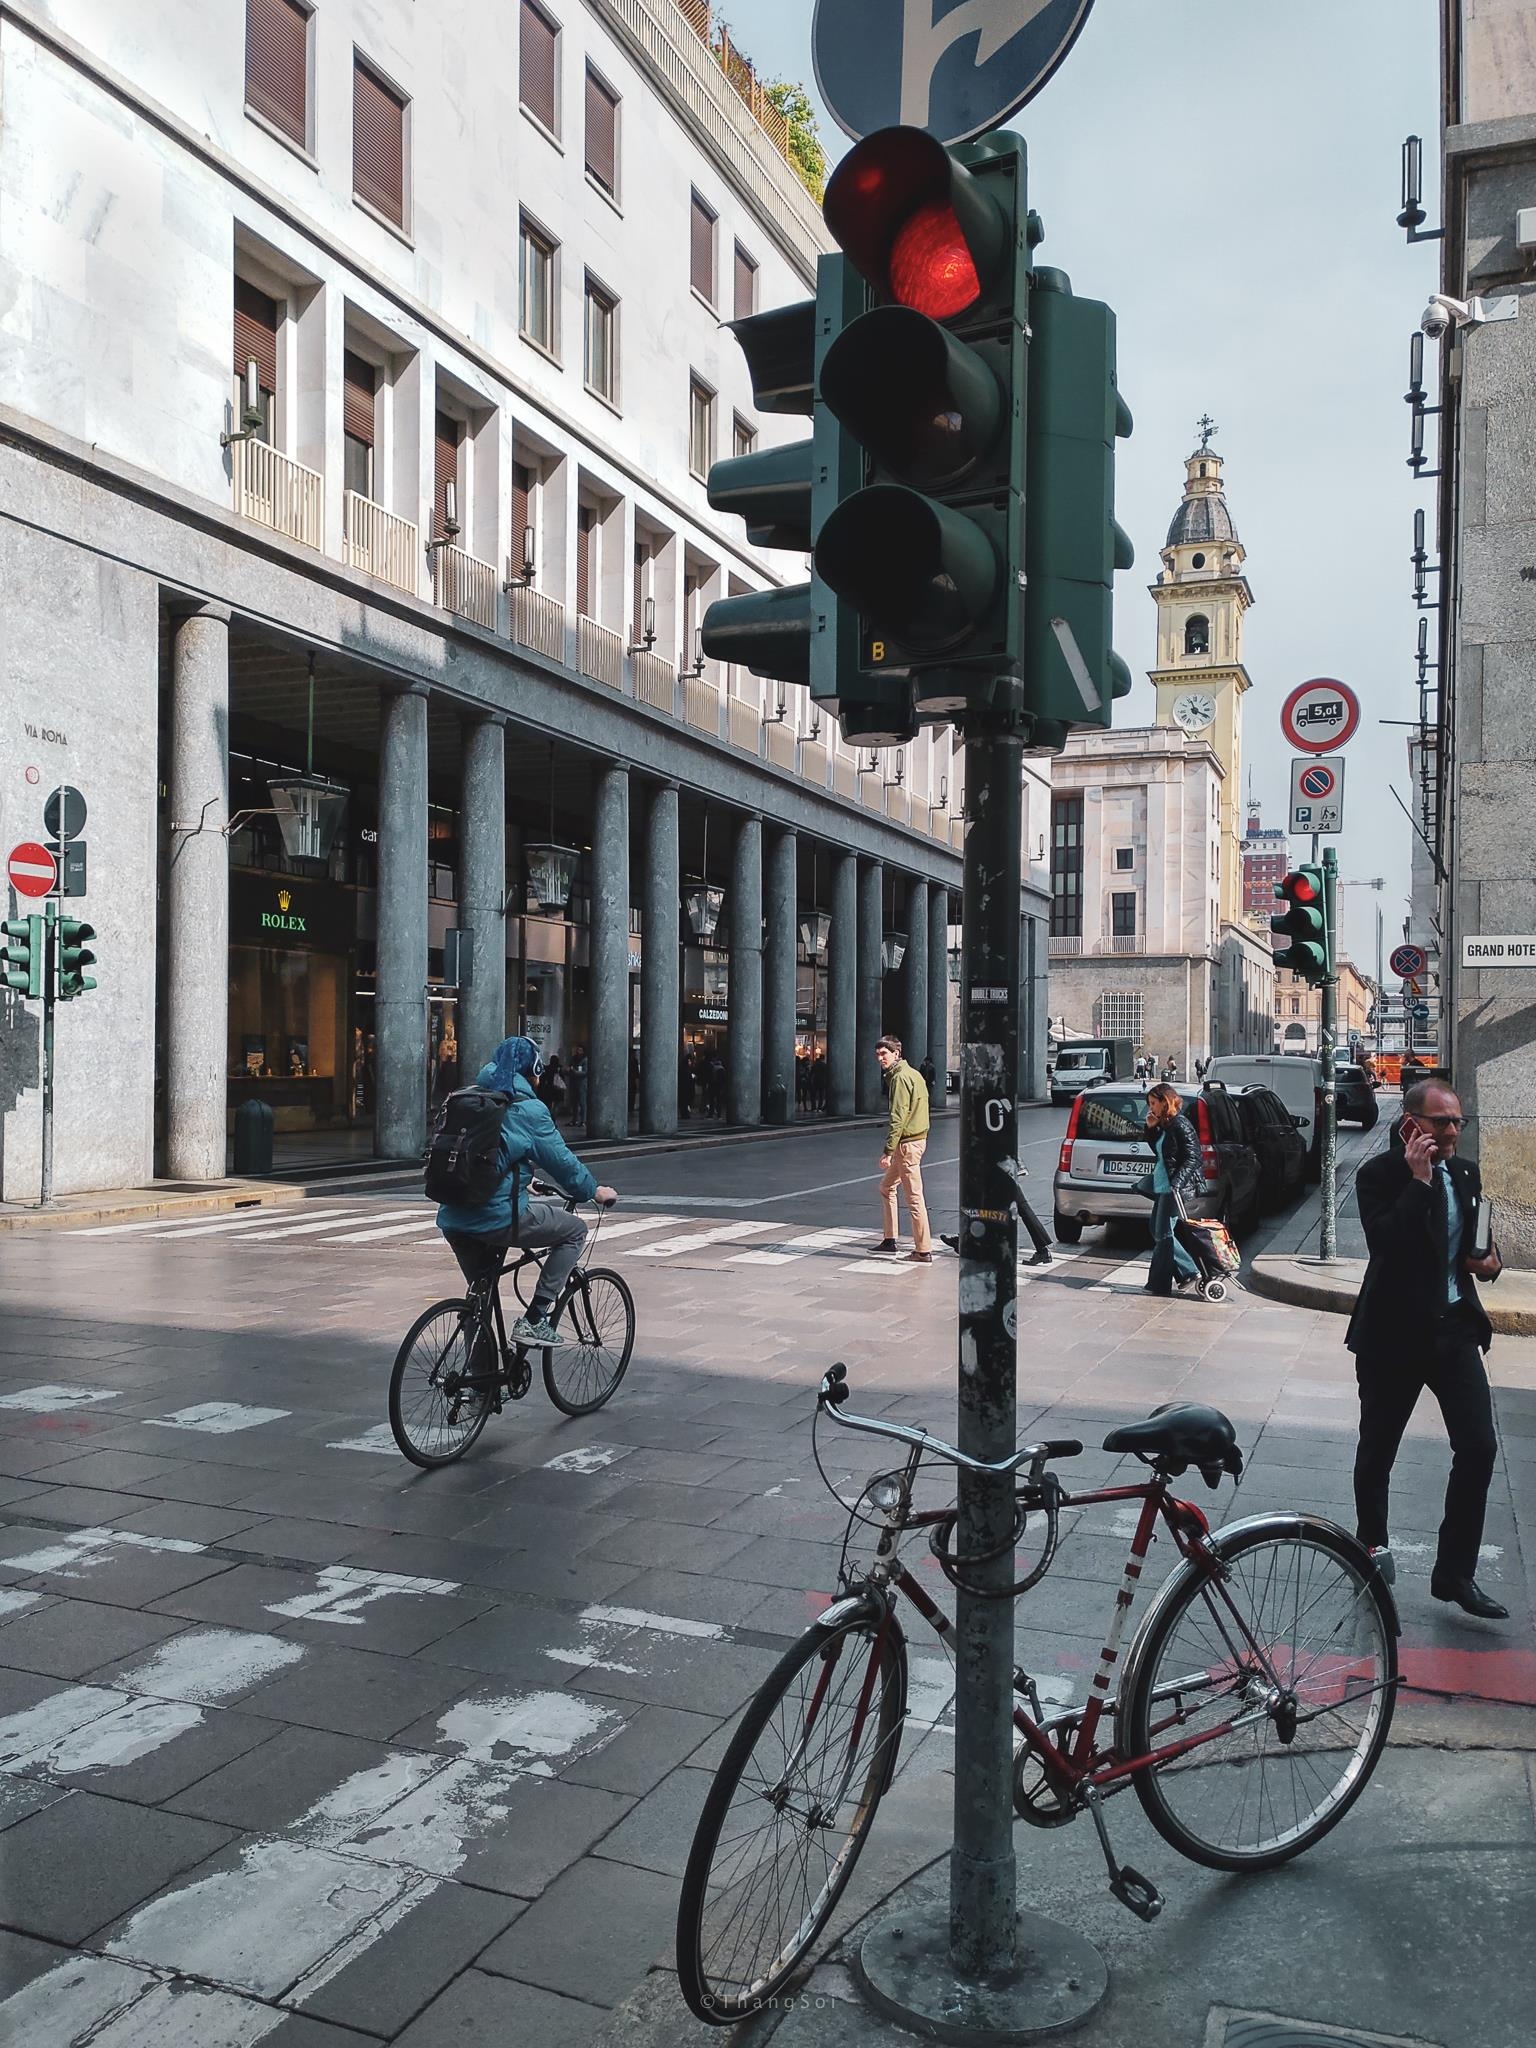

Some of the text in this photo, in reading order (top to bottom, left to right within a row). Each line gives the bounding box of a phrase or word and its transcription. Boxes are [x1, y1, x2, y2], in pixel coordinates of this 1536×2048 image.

[872, 641, 885, 661] B
[24, 723, 68, 746] VIA ROMA
[1298, 808, 1309, 821] P
[1318, 822, 1330, 831] 24
[261, 912, 306, 931] ROLEX
[1467, 944, 1536, 957] GRAND HOTE
[1406, 999, 1416, 1007] 30
